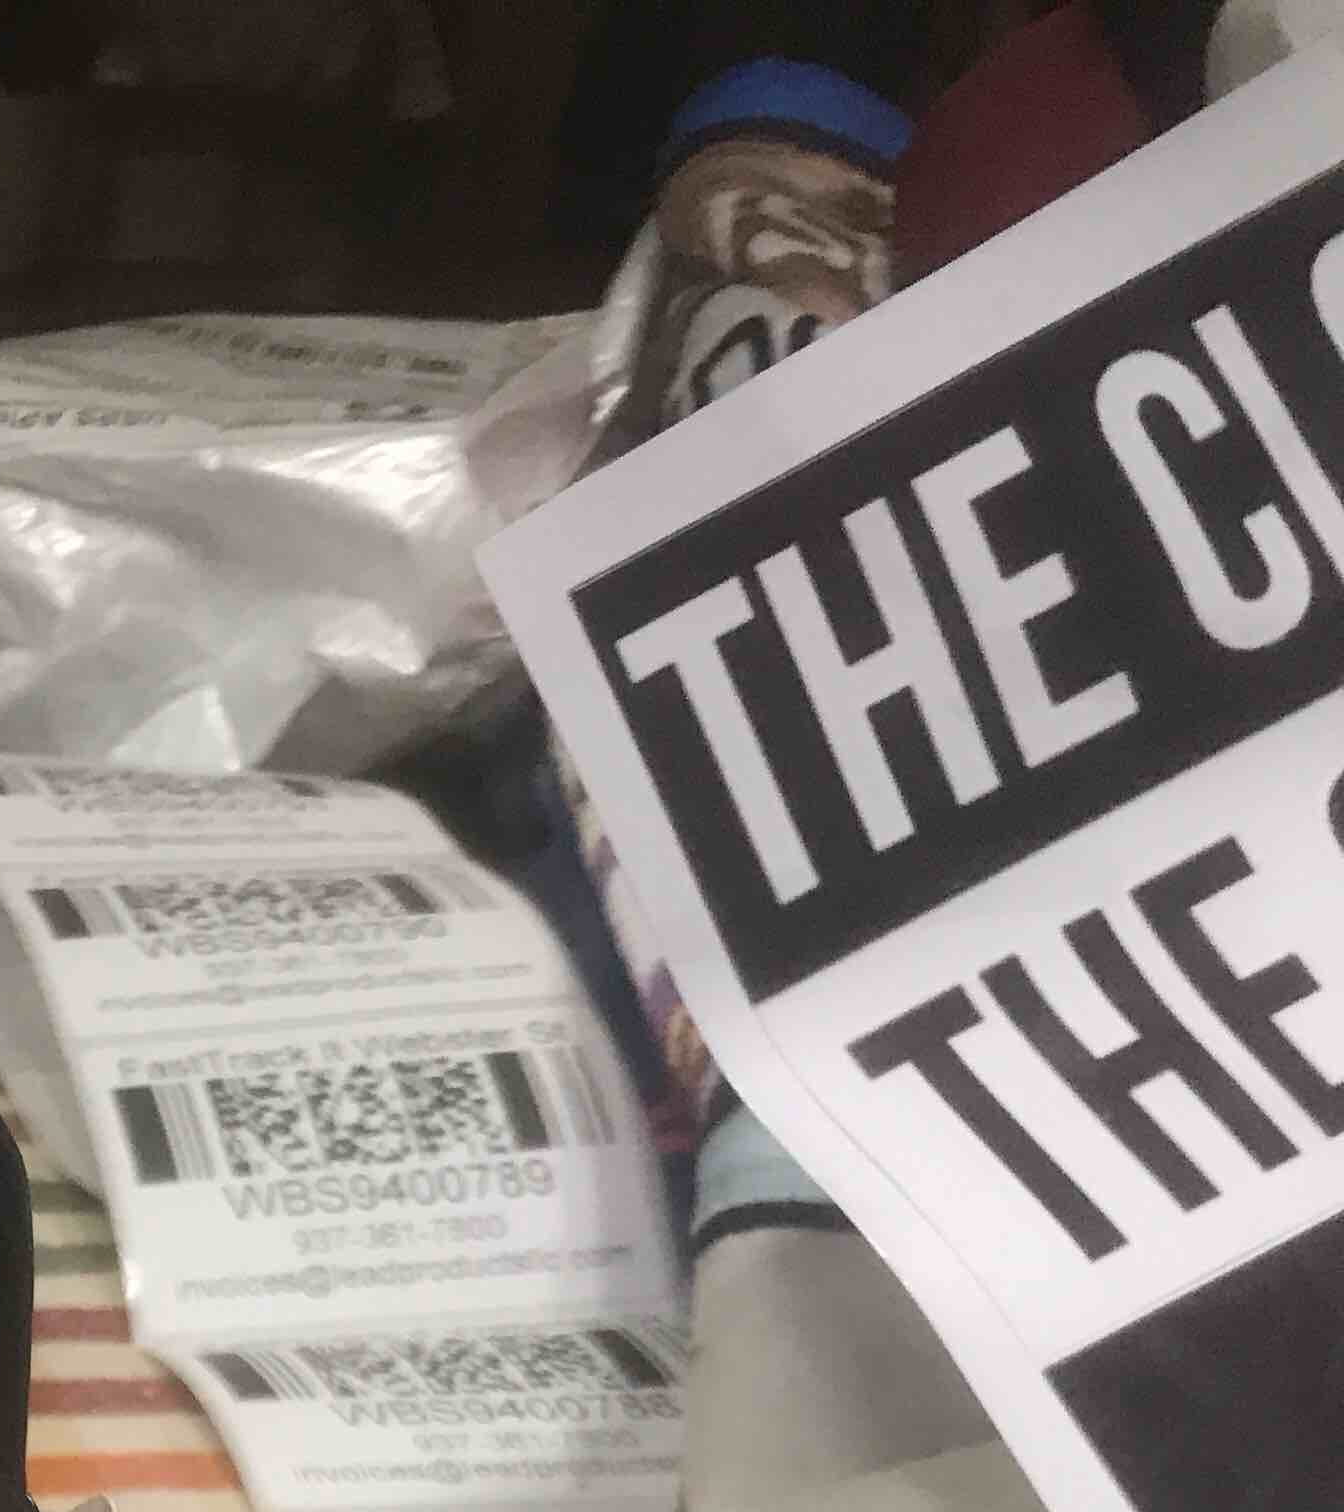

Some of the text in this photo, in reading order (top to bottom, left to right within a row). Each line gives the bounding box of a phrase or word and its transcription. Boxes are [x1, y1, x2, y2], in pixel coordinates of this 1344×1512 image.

[616, 425, 1140, 905] THE
[223, 1157, 555, 1222] WBS9400789
[846, 836, 1344, 1263] THE
